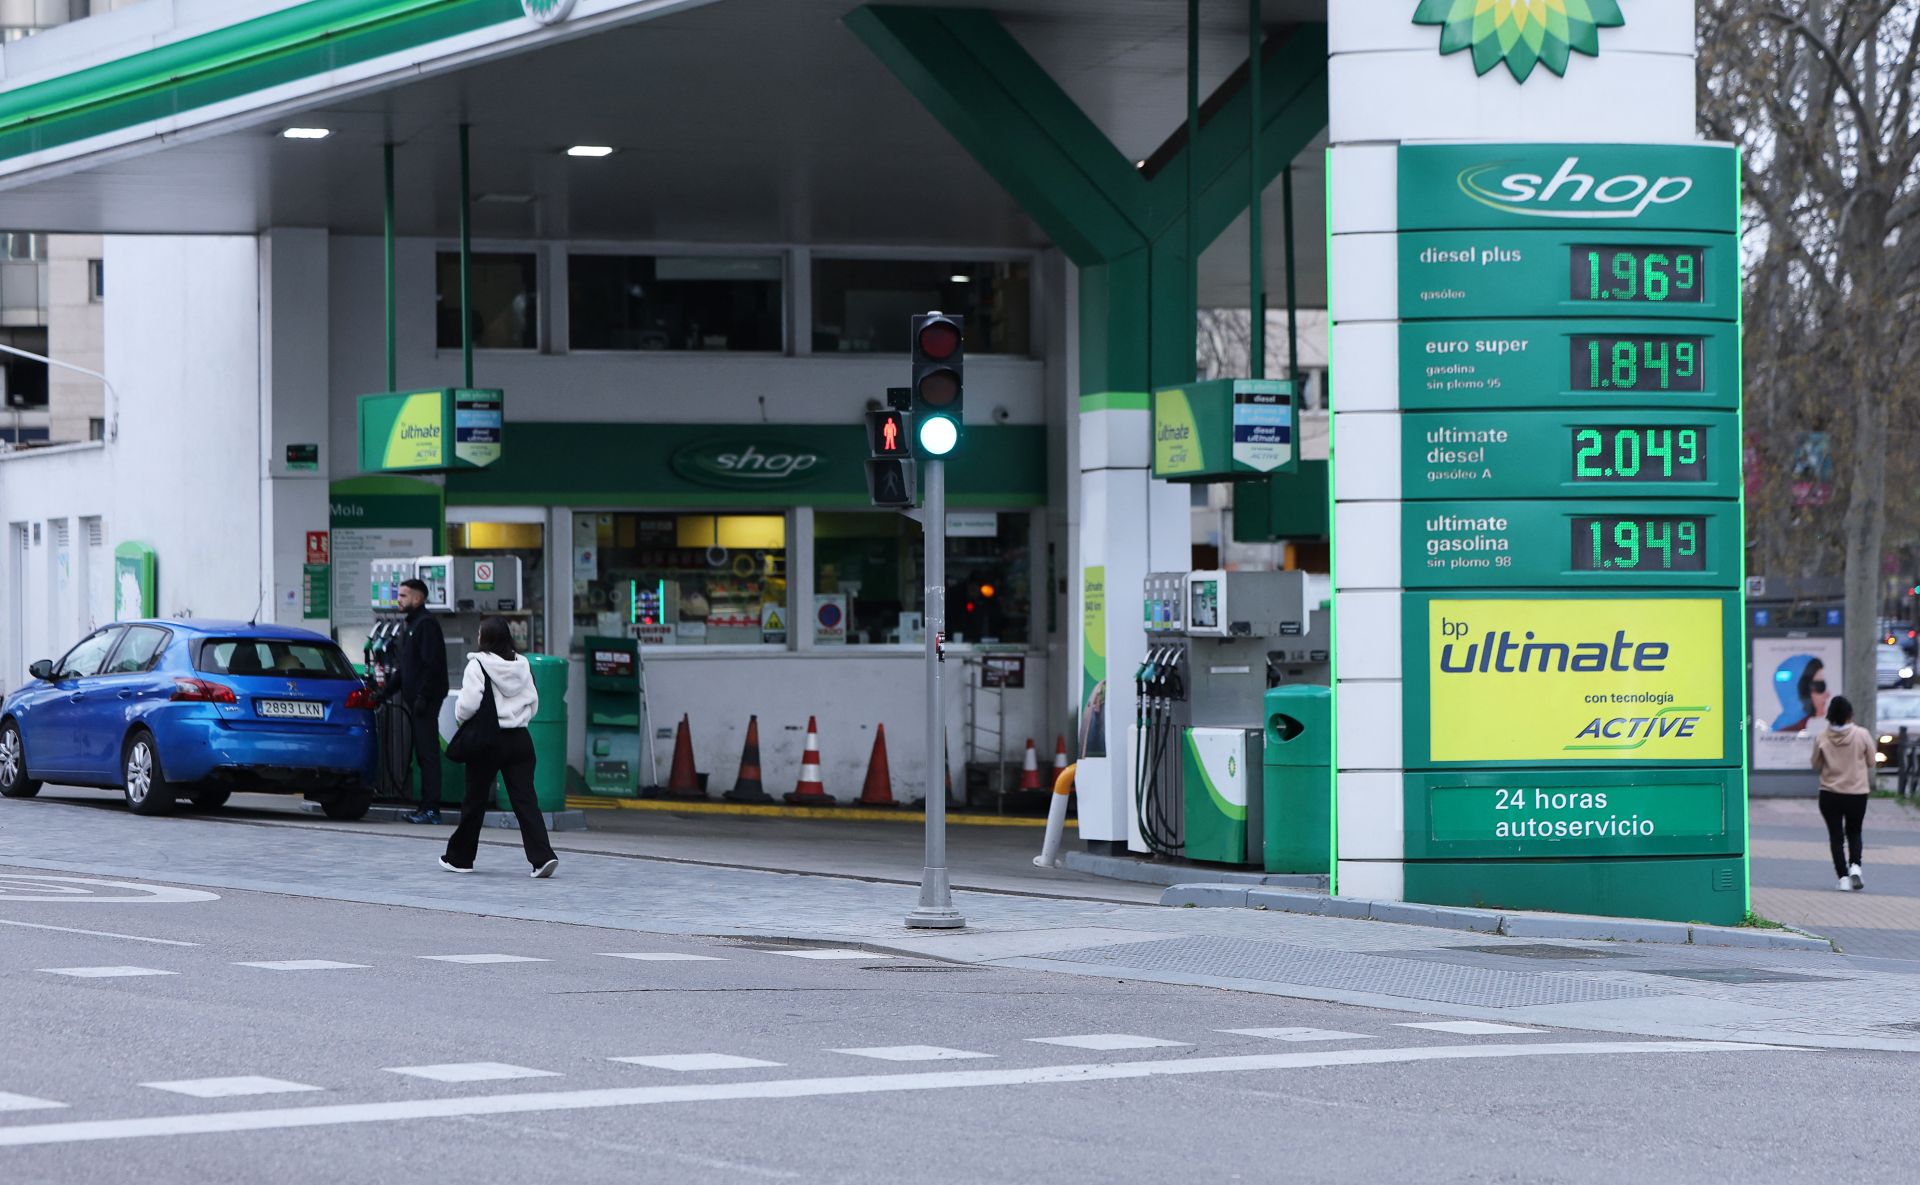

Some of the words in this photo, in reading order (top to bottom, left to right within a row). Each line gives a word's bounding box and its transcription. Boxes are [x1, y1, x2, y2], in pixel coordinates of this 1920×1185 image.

[1502, 157, 1693, 218] shop
[1420, 247, 1475, 263] diesel
[1482, 247, 1521, 265] plus
[1588, 252, 1694, 301] 1.969
[1420, 289, 1466, 301] gasóleo
[1426, 340, 1469, 354] euro
[1475, 340, 1529, 355] super
[1426, 364, 1475, 377] gasolina
[1588, 341, 1694, 389] 1.849
[1426, 380, 1445, 390] sin
[1447, 379, 1484, 391] plomo
[1487, 378, 1501, 389] 95
[401, 424, 440, 440] ultimate
[1427, 427, 1507, 443] ultimate
[717, 445, 817, 478] shop
[1427, 448, 1484, 463] diesel
[1577, 429, 1697, 477] 2.049
[1427, 469, 1477, 482] gasóleo
[1481, 468, 1492, 479] A
[1426, 515, 1507, 531] ultimate
[1427, 535, 1508, 555] gasolina
[1590, 521, 1696, 568] 1.949
[1427, 557, 1445, 567] sin
[1451, 557, 1489, 570] plomo
[1495, 556, 1511, 567] 98
[1442, 618, 1469, 639] bp
[1440, 630, 1669, 673] ultimate
[1584, 694, 1607, 703] con
[265, 702, 295, 714] 2893
[298, 704, 320, 715] LKN
[1575, 716, 1700, 739] ACTIVE
[1495, 789, 1526, 810] 24
[1535, 788, 1608, 809] horas
[1496, 815, 1654, 837] autoservicio
